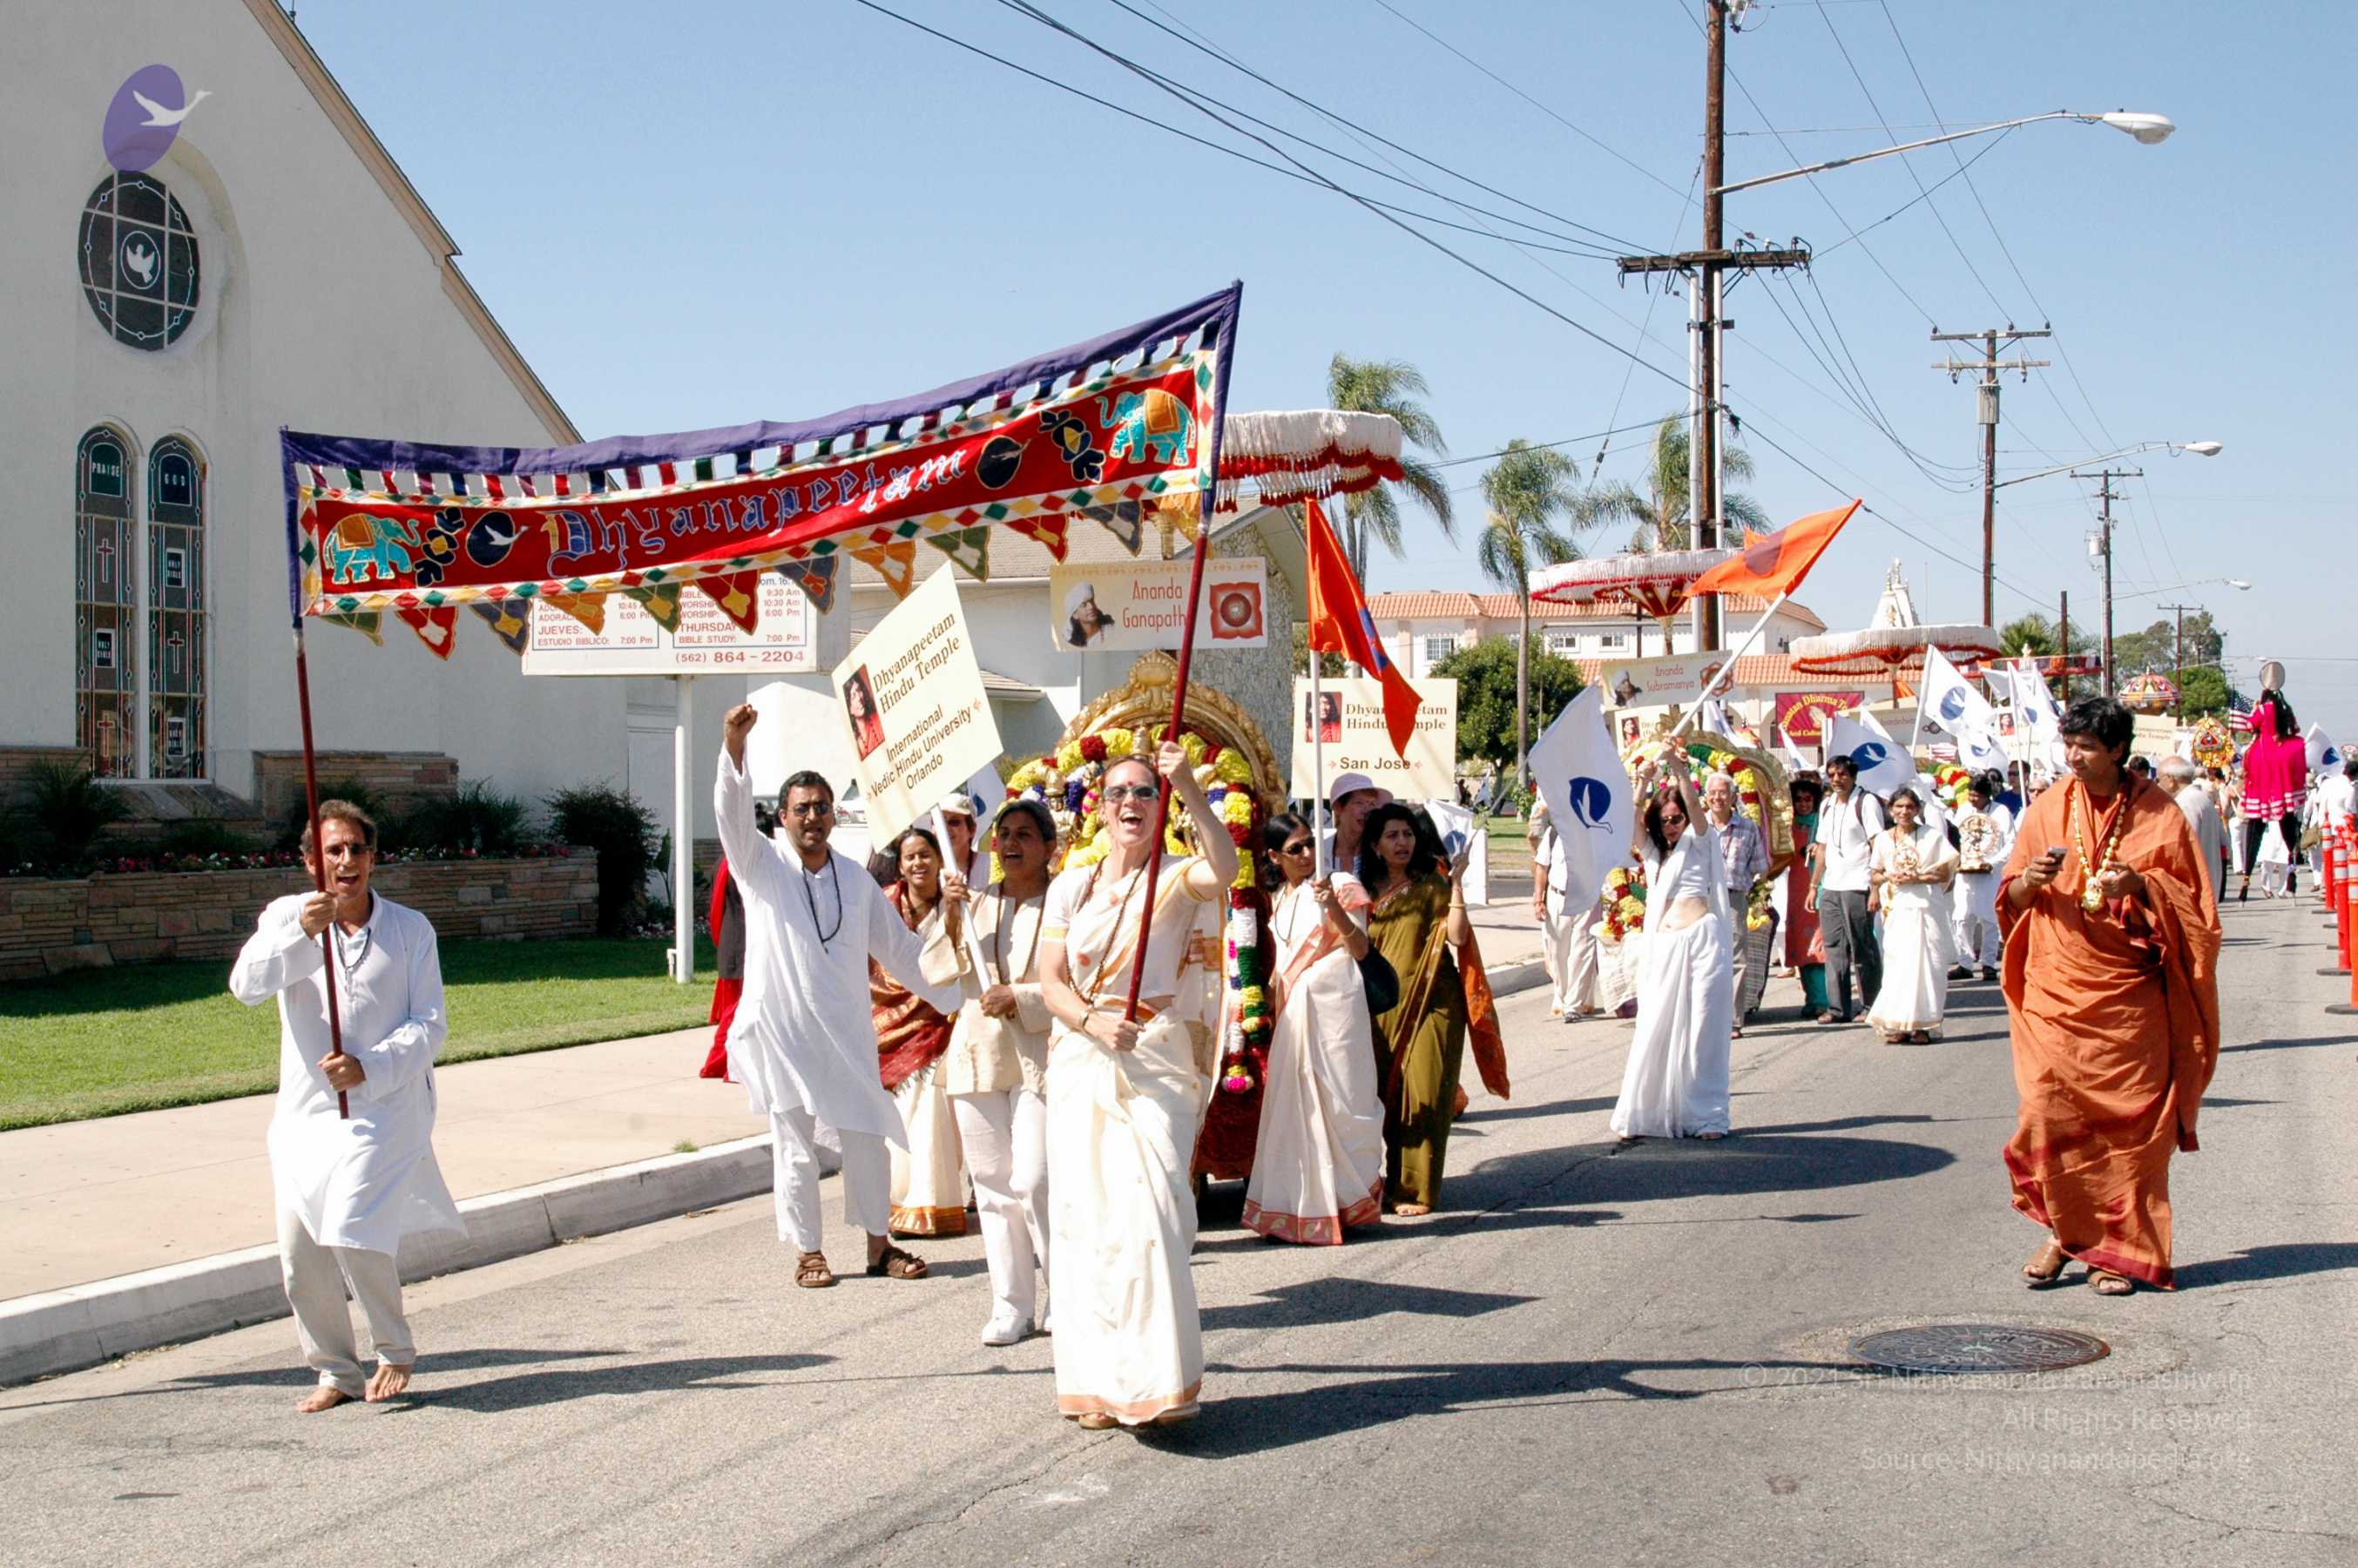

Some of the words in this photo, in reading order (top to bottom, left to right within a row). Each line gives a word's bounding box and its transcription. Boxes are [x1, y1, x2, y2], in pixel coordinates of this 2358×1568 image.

[91, 463, 120, 477] PRAISE
[164, 473, 186, 486] GOD
[536, 449, 967, 578] Dhyanapeetam
[1132, 578, 1183, 600] Ananda
[1123, 605, 1186, 633] Ganapath
[538, 625, 583, 635] JUEVES:
[538, 638, 571, 646] ESTUDIO
[620, 636, 636, 645] 7:00
[676, 652, 706, 663] (562)
[873, 613, 956, 693] Dhyanapeetam
[879, 677, 915, 714] Hindu
[915, 637, 960, 680] Temple
[1802, 693, 1838, 706] Dharma
[1347, 704, 1447, 717] Dhyatam
[1416, 719, 1446, 731] mple
[887, 704, 943, 762] International
[871, 772, 895, 797] Vedic
[895, 747, 923, 778] Hindu
[922, 706, 971, 753] University
[1340, 757, 1368, 770] San
[1375, 757, 1410, 770] Jose
[906, 754, 943, 789] Orlando
